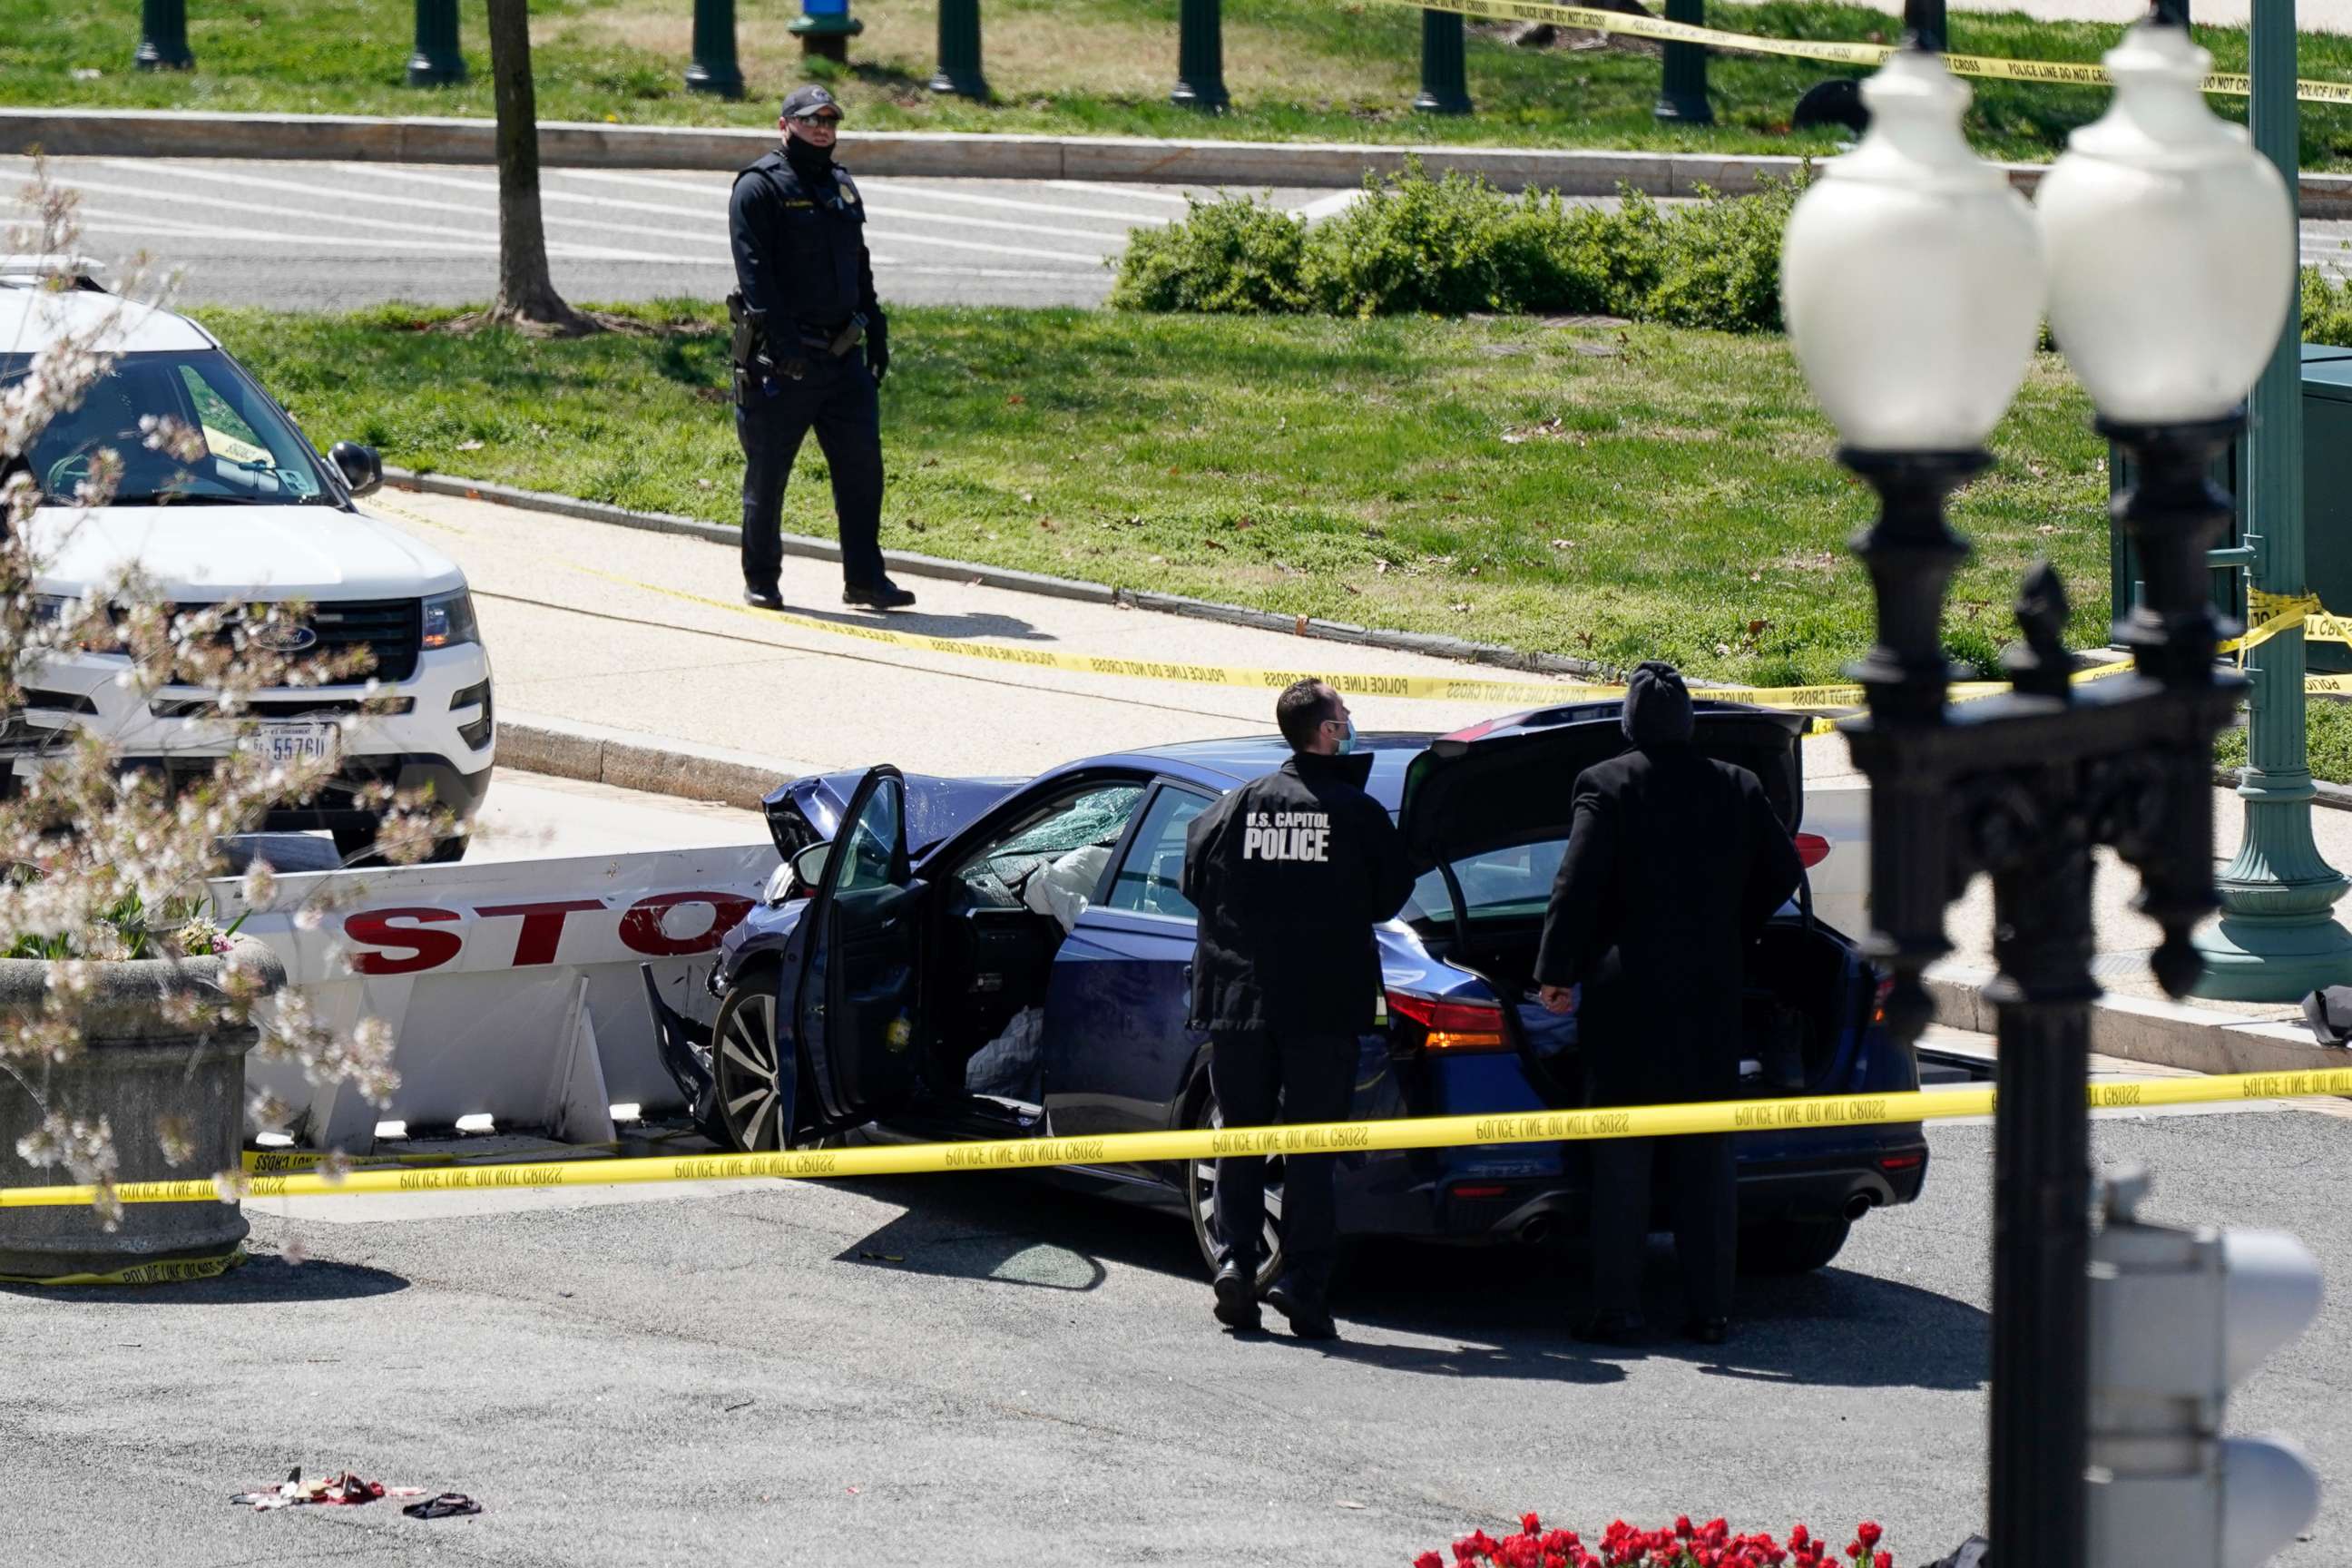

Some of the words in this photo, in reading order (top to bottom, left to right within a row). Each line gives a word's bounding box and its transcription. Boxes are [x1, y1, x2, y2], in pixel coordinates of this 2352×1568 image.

[1953, 58, 1981, 72] CROSS
[2008, 64, 2038, 77] POLICE
[2039, 65, 2058, 79] LINE
[2059, 67, 2073, 80] DO
[2073, 68, 2090, 82] NOT
[2218, 76, 2234, 90] NOT
[2298, 83, 2328, 97] POLICE
[1246, 812, 1271, 828] U.S.
[1275, 812, 1331, 828] CAPITOL
[1243, 828, 1331, 862] POLICE
